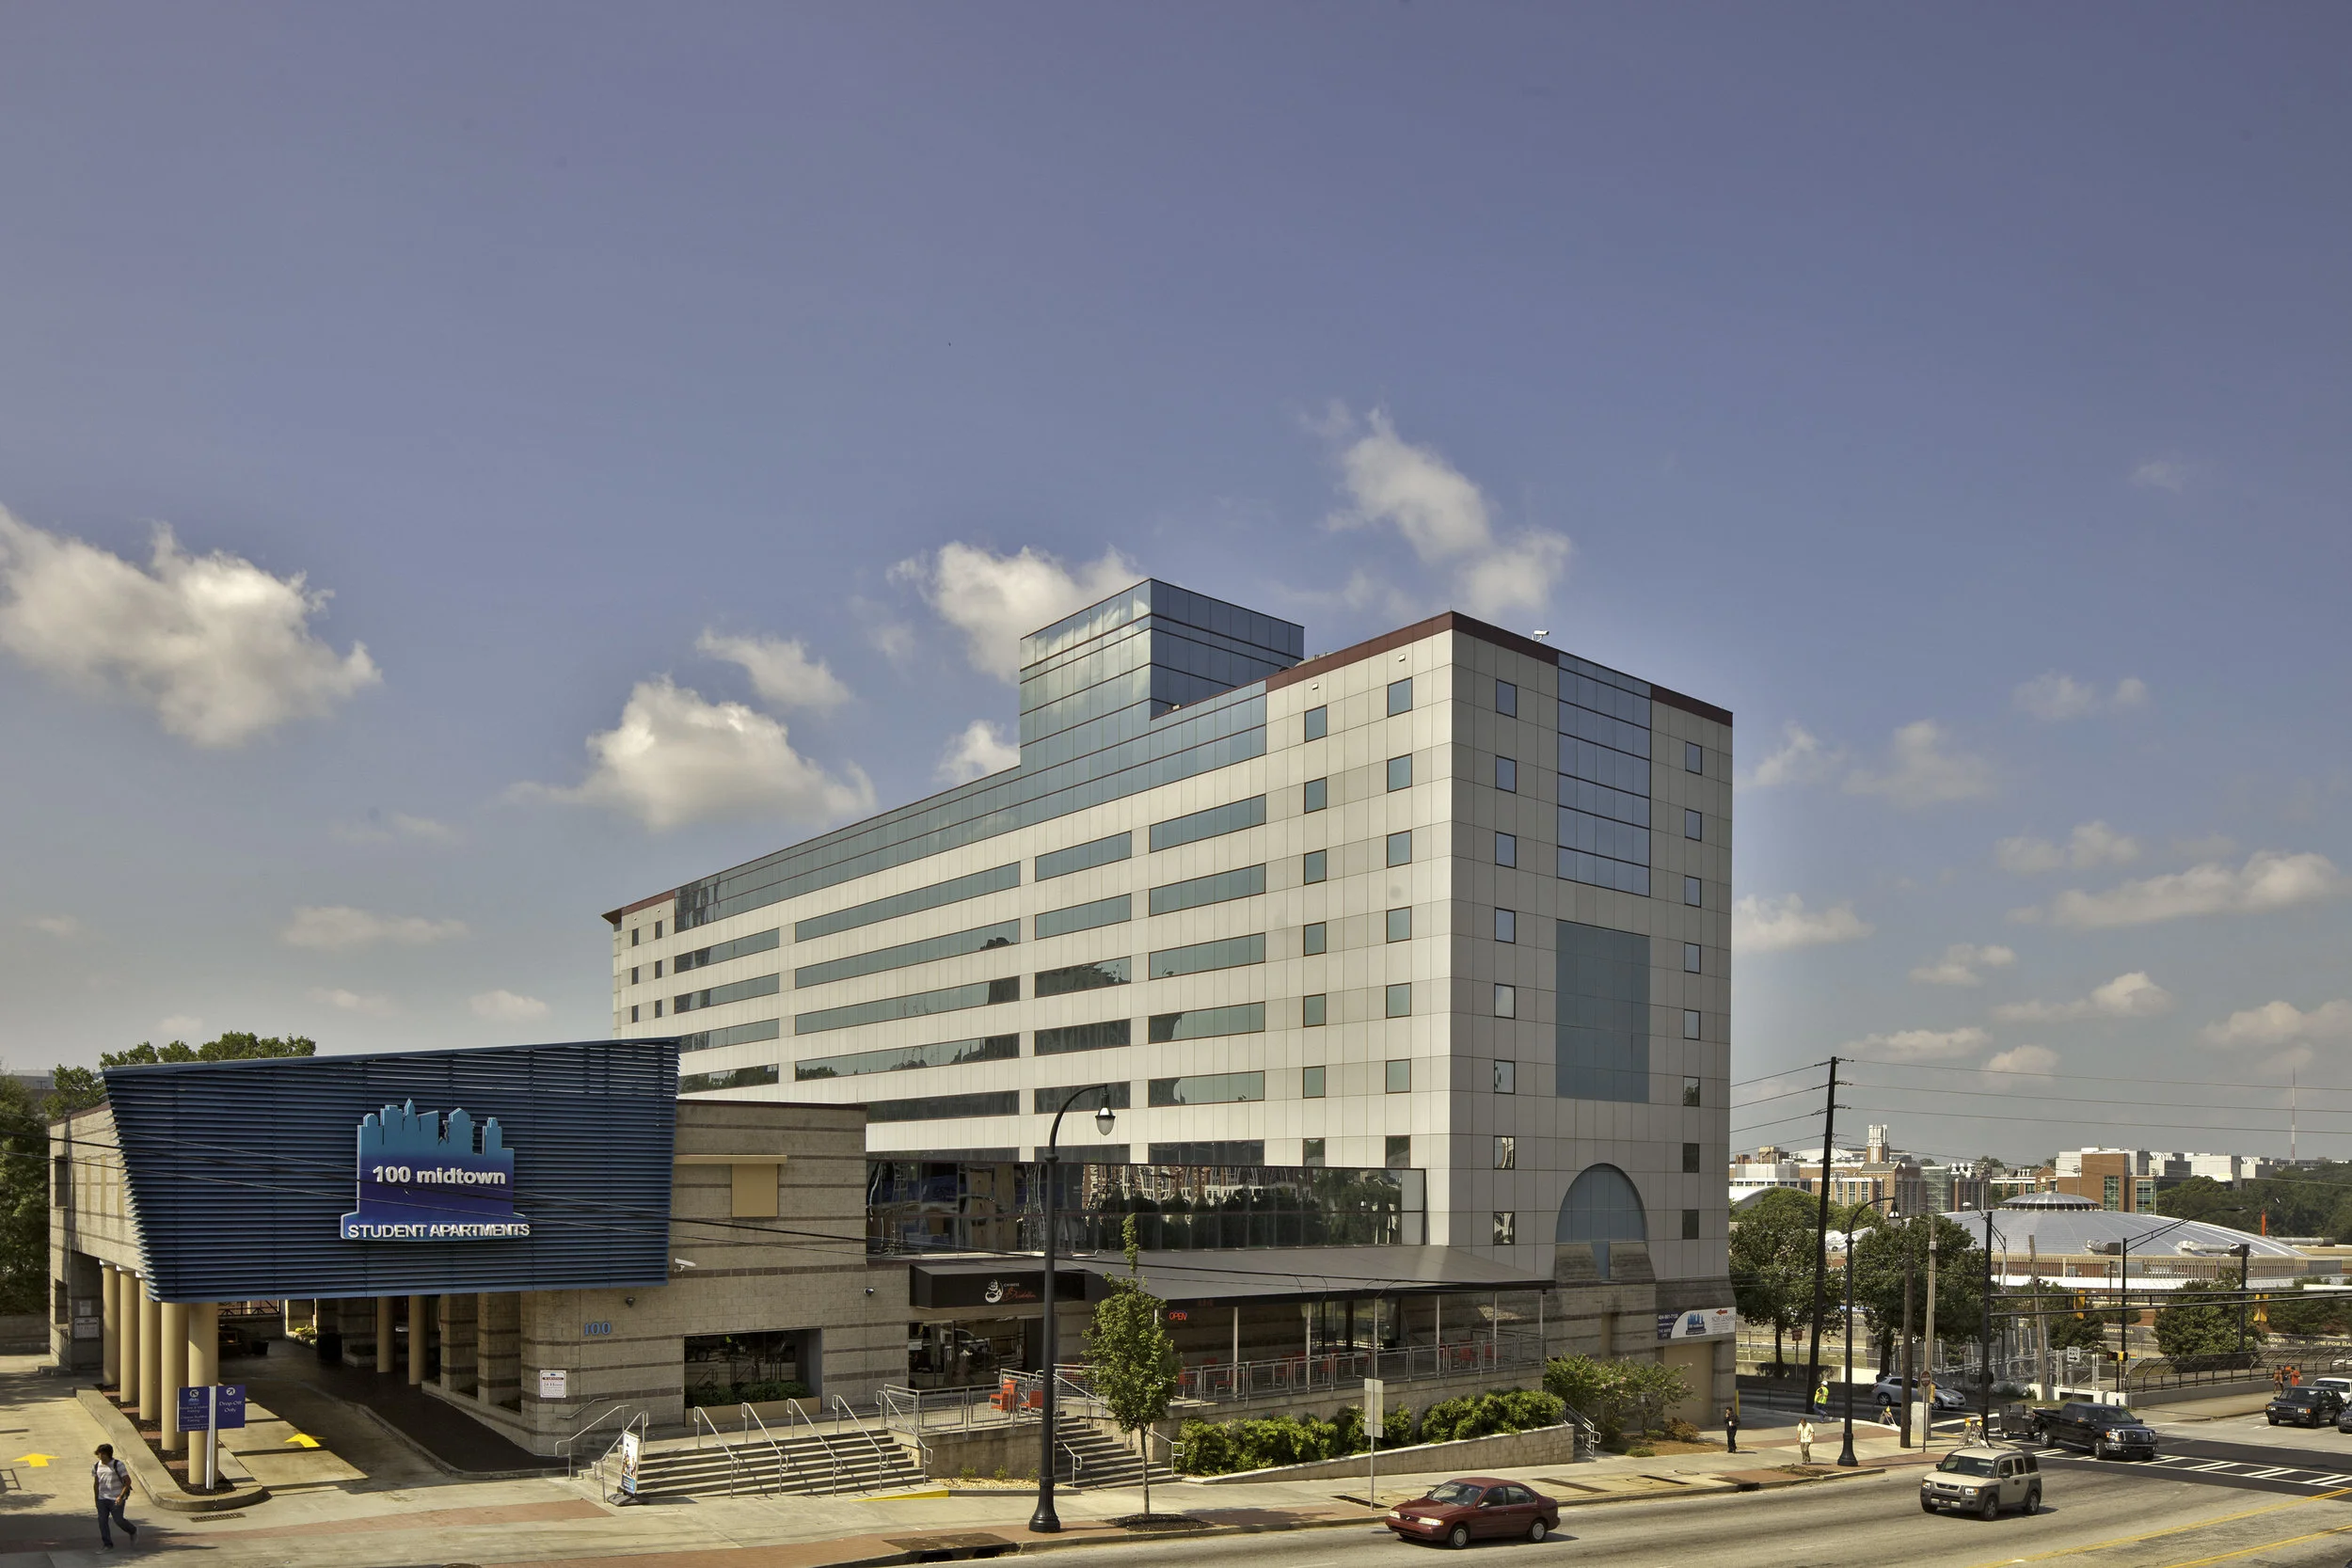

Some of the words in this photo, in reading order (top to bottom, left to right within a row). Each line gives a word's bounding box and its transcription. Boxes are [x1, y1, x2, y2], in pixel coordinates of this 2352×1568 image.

[373, 1165, 411, 1183] 100
[417, 1167, 506, 1184] midtown
[347, 1224, 427, 1238] STUDENT
[429, 1224, 531, 1238] APARTMENTS
[1168, 1311, 1187, 1321] OPEN
[585, 1323, 611, 1336] 100
